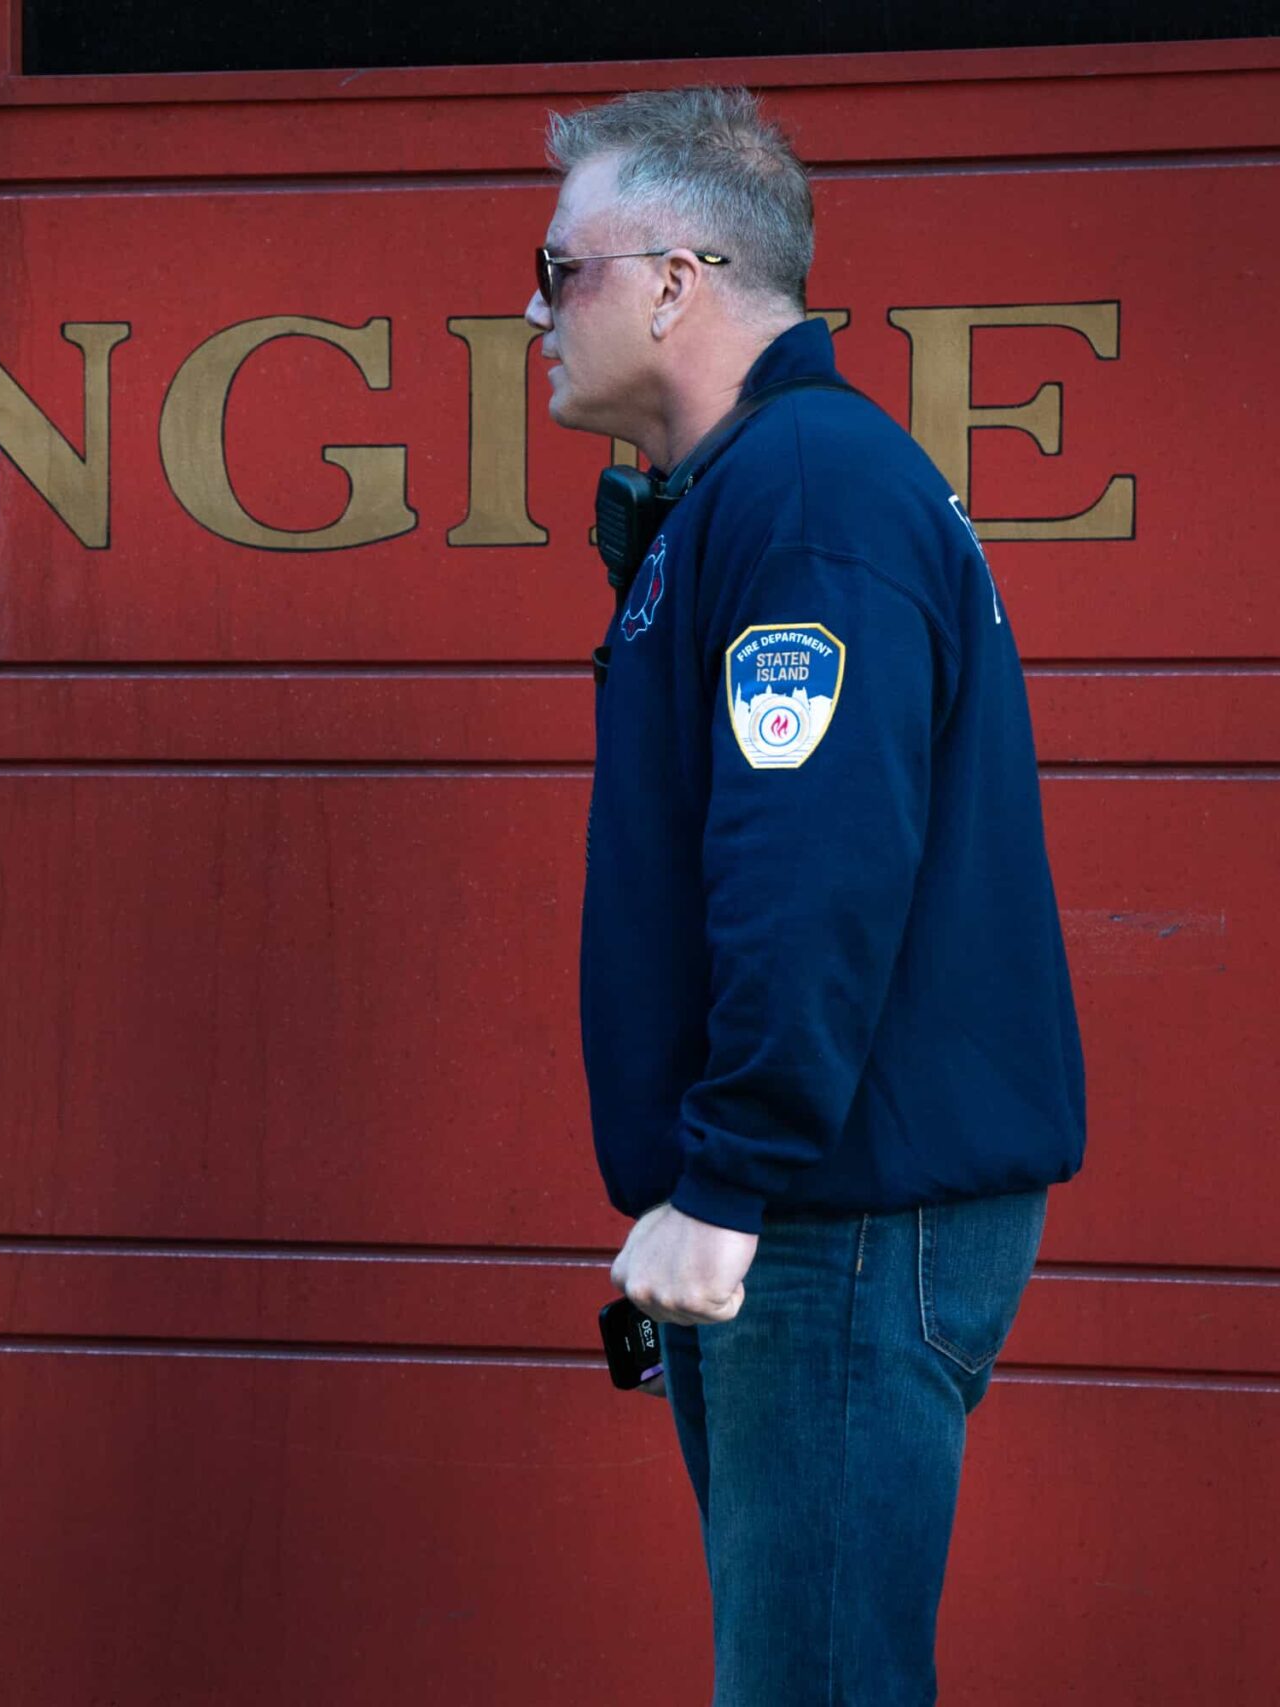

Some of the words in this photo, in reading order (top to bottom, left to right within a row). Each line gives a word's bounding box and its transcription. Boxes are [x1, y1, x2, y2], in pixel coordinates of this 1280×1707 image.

[737, 641, 760, 662] FIRE
[761, 633, 832, 657] DEPARTMENT
[757, 652, 810, 667] STATEN
[757, 667, 809, 682] ISLAND
[642, 1320, 655, 1348] 4:30
